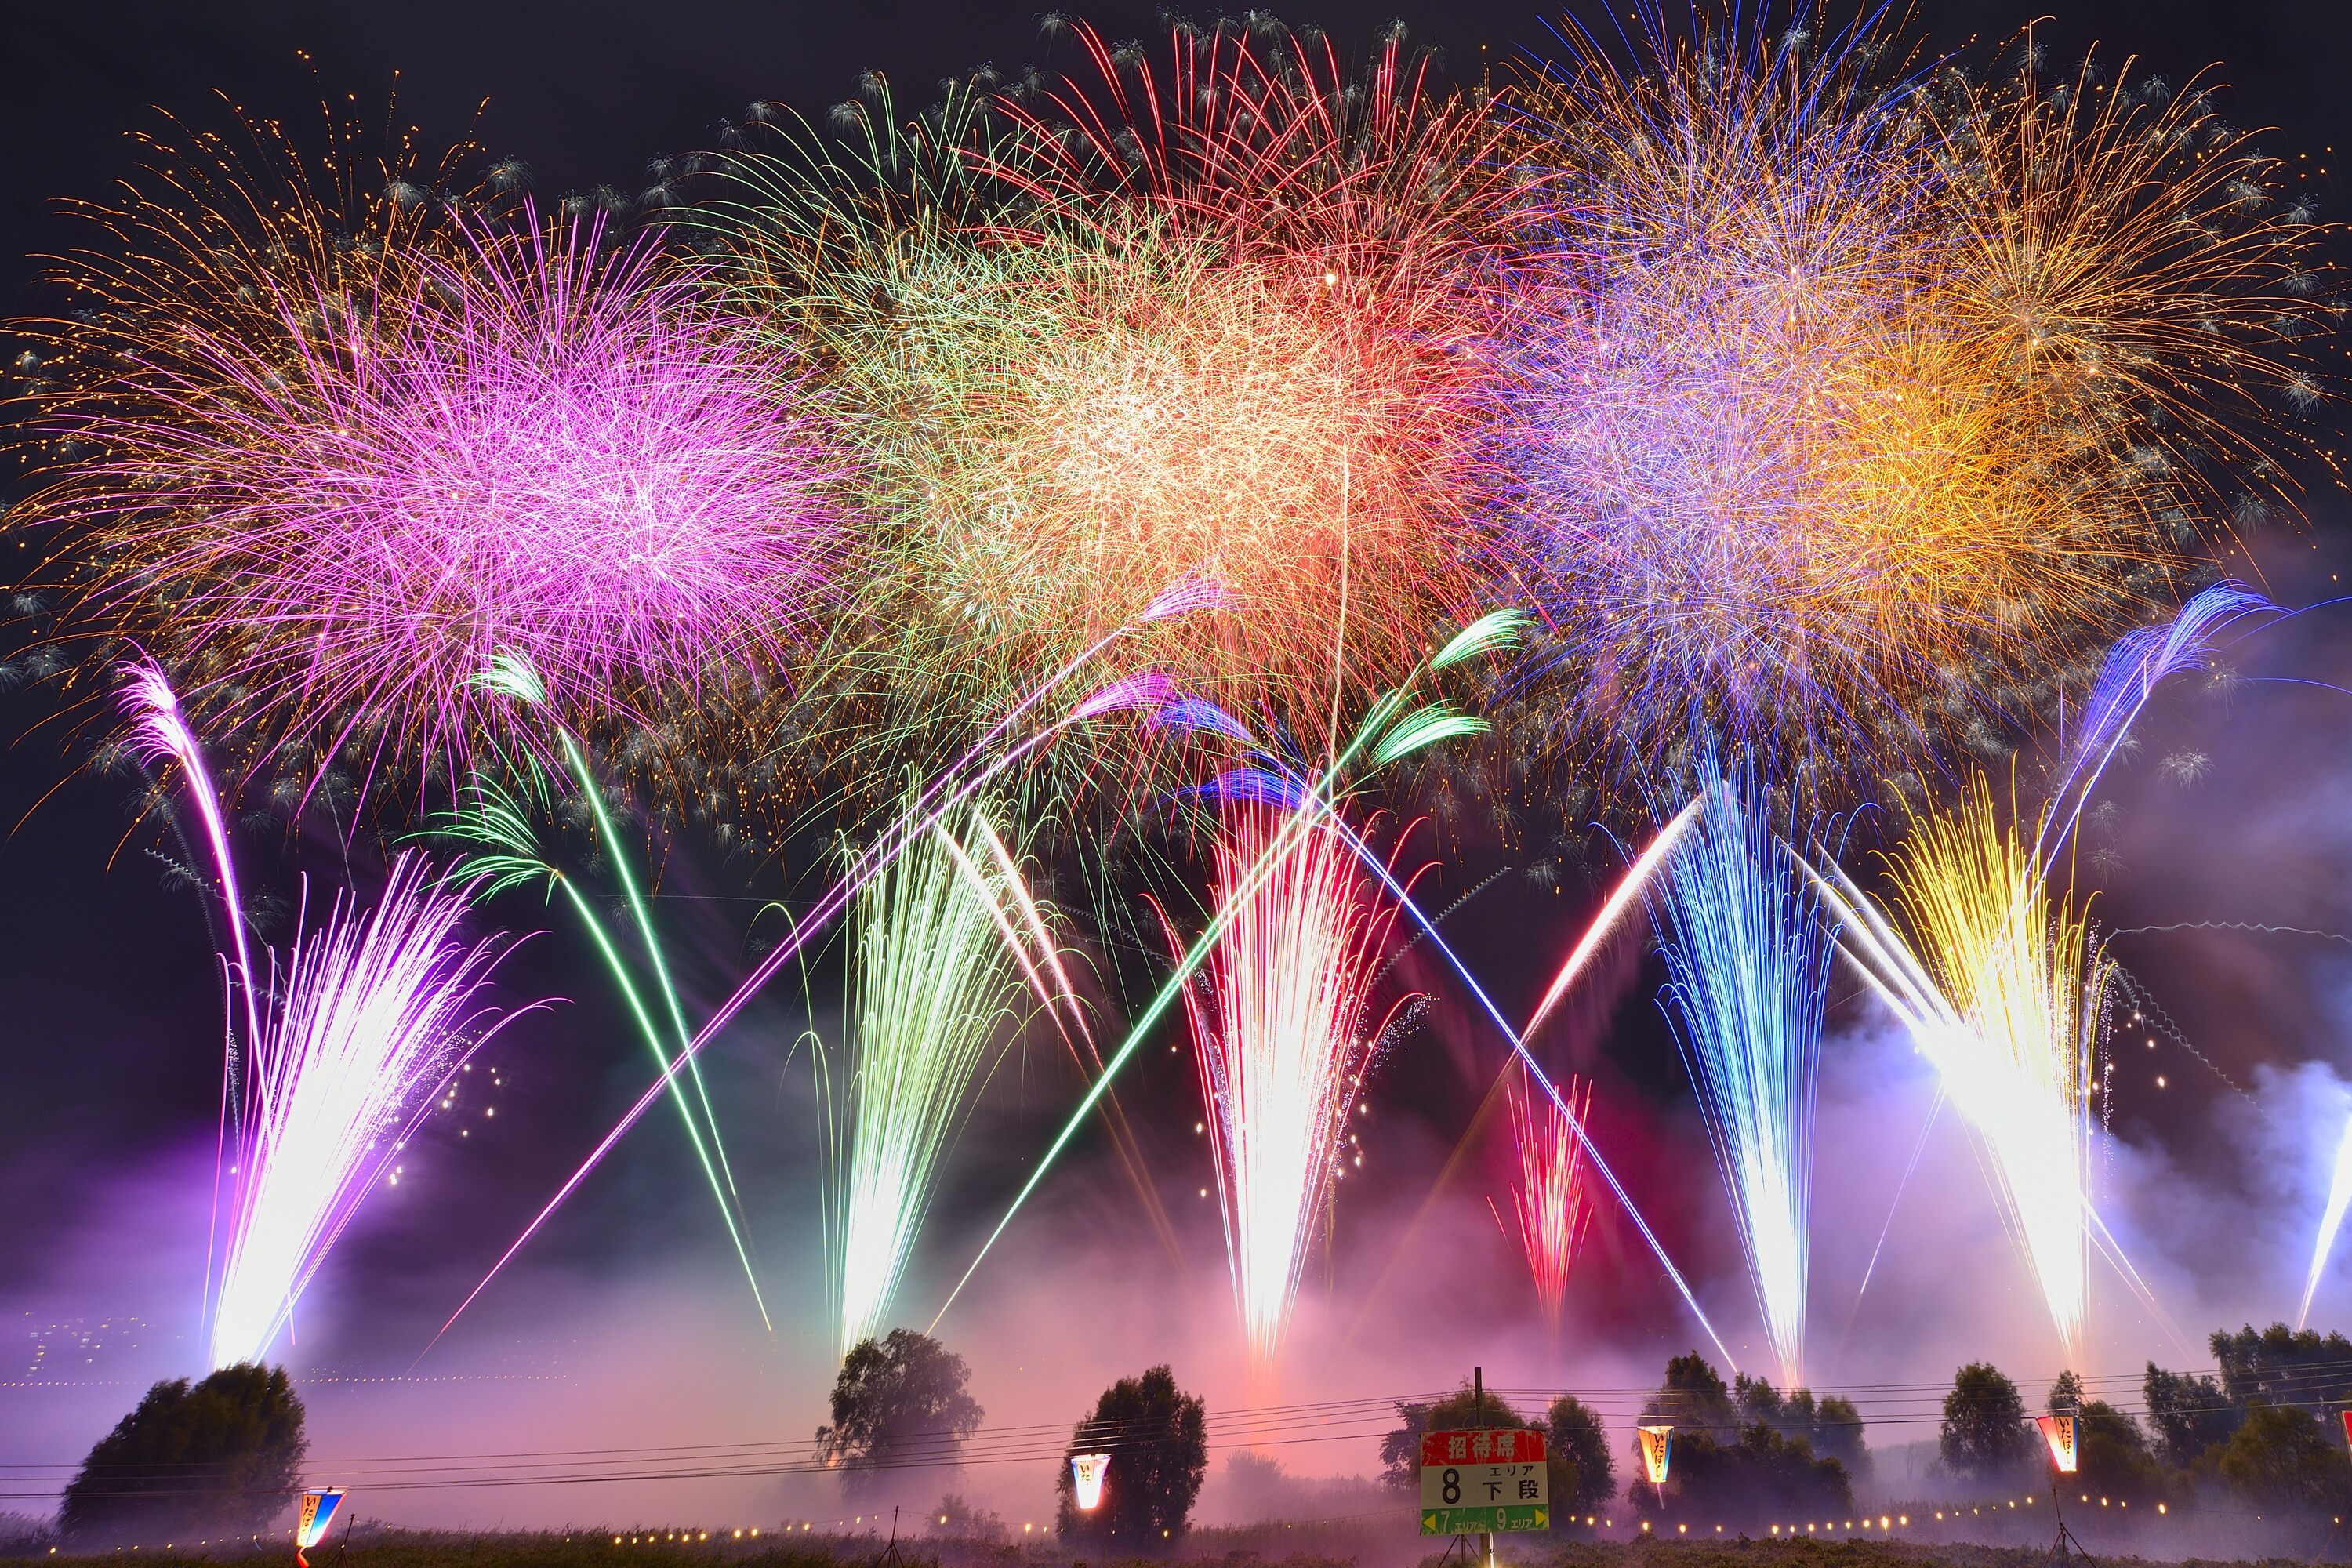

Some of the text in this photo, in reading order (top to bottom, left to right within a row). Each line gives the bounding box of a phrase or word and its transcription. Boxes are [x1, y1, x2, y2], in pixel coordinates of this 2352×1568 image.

[1448, 1435, 1515, 1459] 招待席
[1654, 1433, 1664, 1478] いたばし
[1490, 1465, 1534, 1476] エリア
[1442, 1468, 1461, 1504] 8
[1483, 1479, 1539, 1501] 下段
[1440, 1510, 1477, 1533] 7 エリア
[1496, 1508, 1533, 1530] 9 エリア
